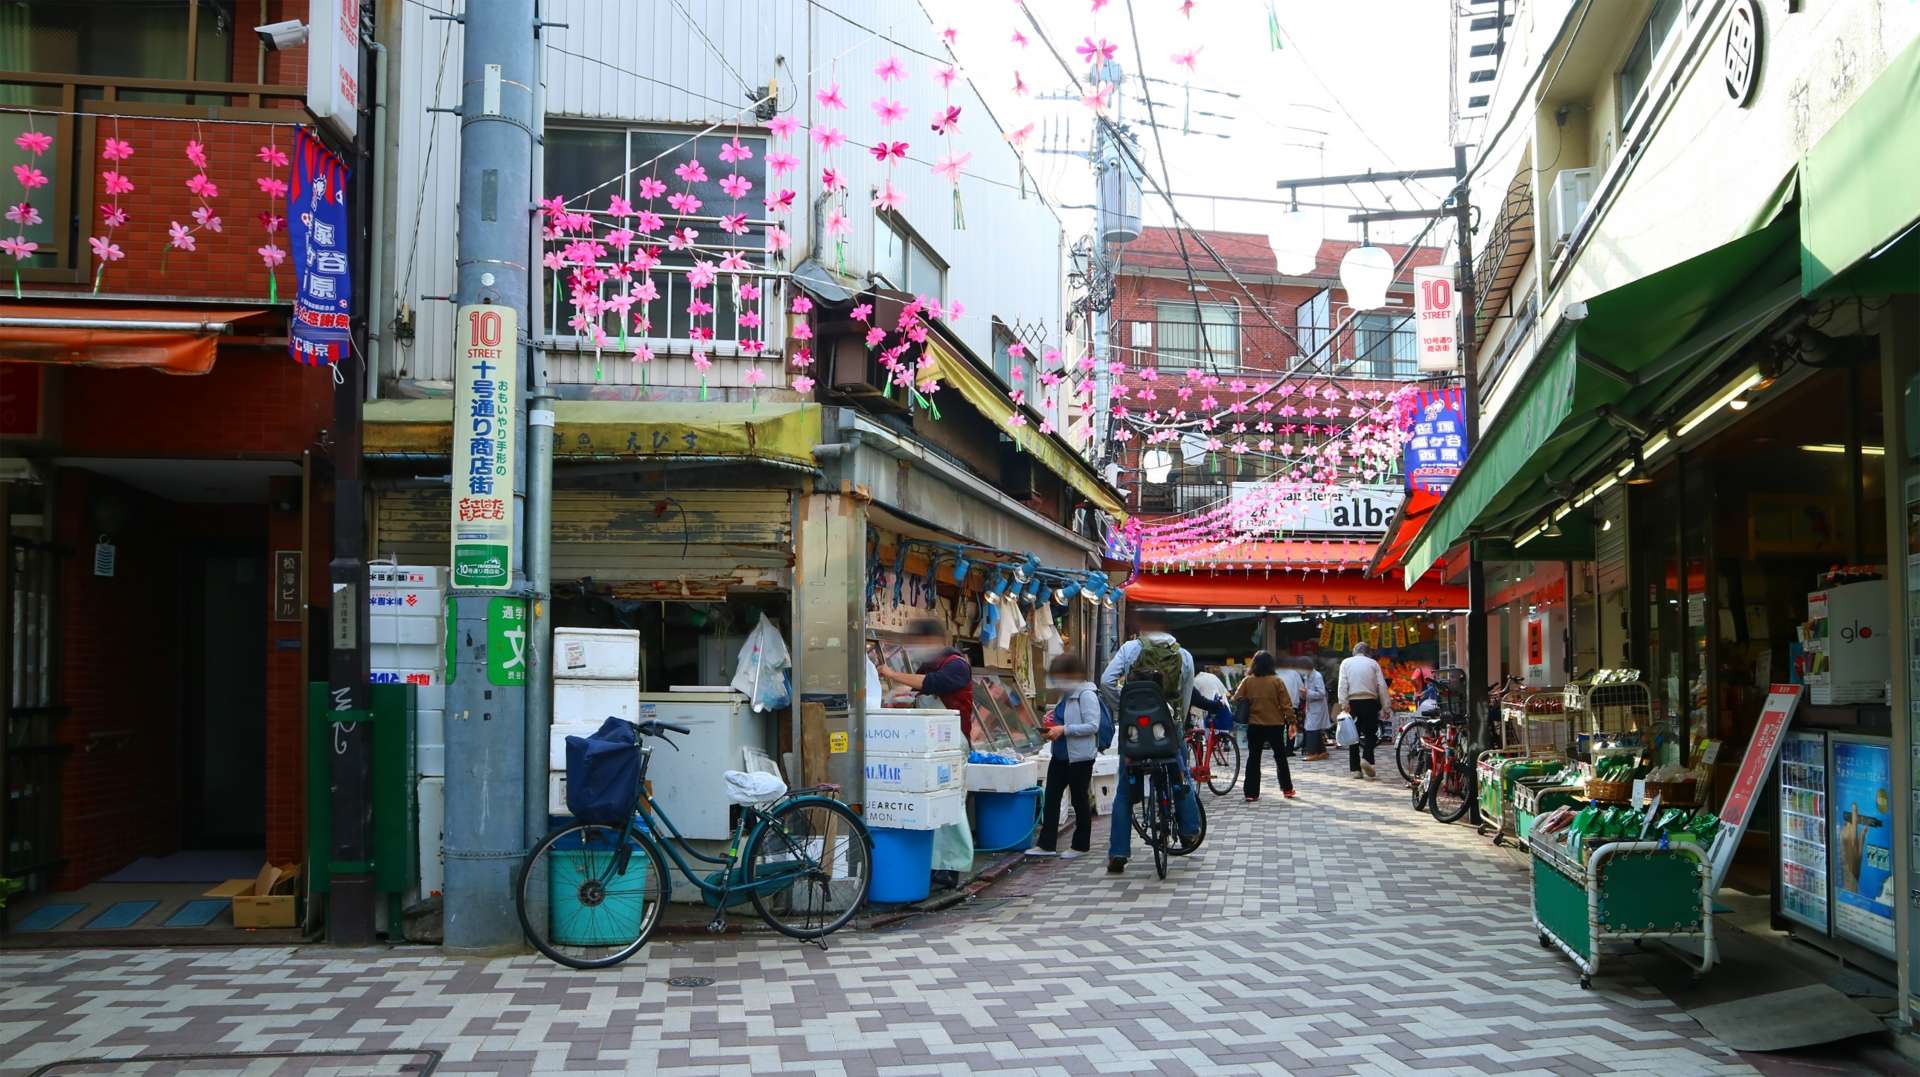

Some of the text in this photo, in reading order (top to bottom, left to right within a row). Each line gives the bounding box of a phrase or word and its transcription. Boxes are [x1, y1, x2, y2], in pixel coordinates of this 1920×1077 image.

[1422, 280, 1450, 310] 10
[1423, 311, 1451, 320] STREET
[470, 311, 501, 346] 10
[1424, 337, 1452, 345] 10号通り
[468, 349, 502, 359] STREET
[469, 360, 497, 495] 十号通り商店街
[497, 381, 508, 476] おもいやり手形の
[458, 497, 505, 510] ささはた
[502, 605, 526, 619] 通学
[1840, 619, 1873, 644] glo
